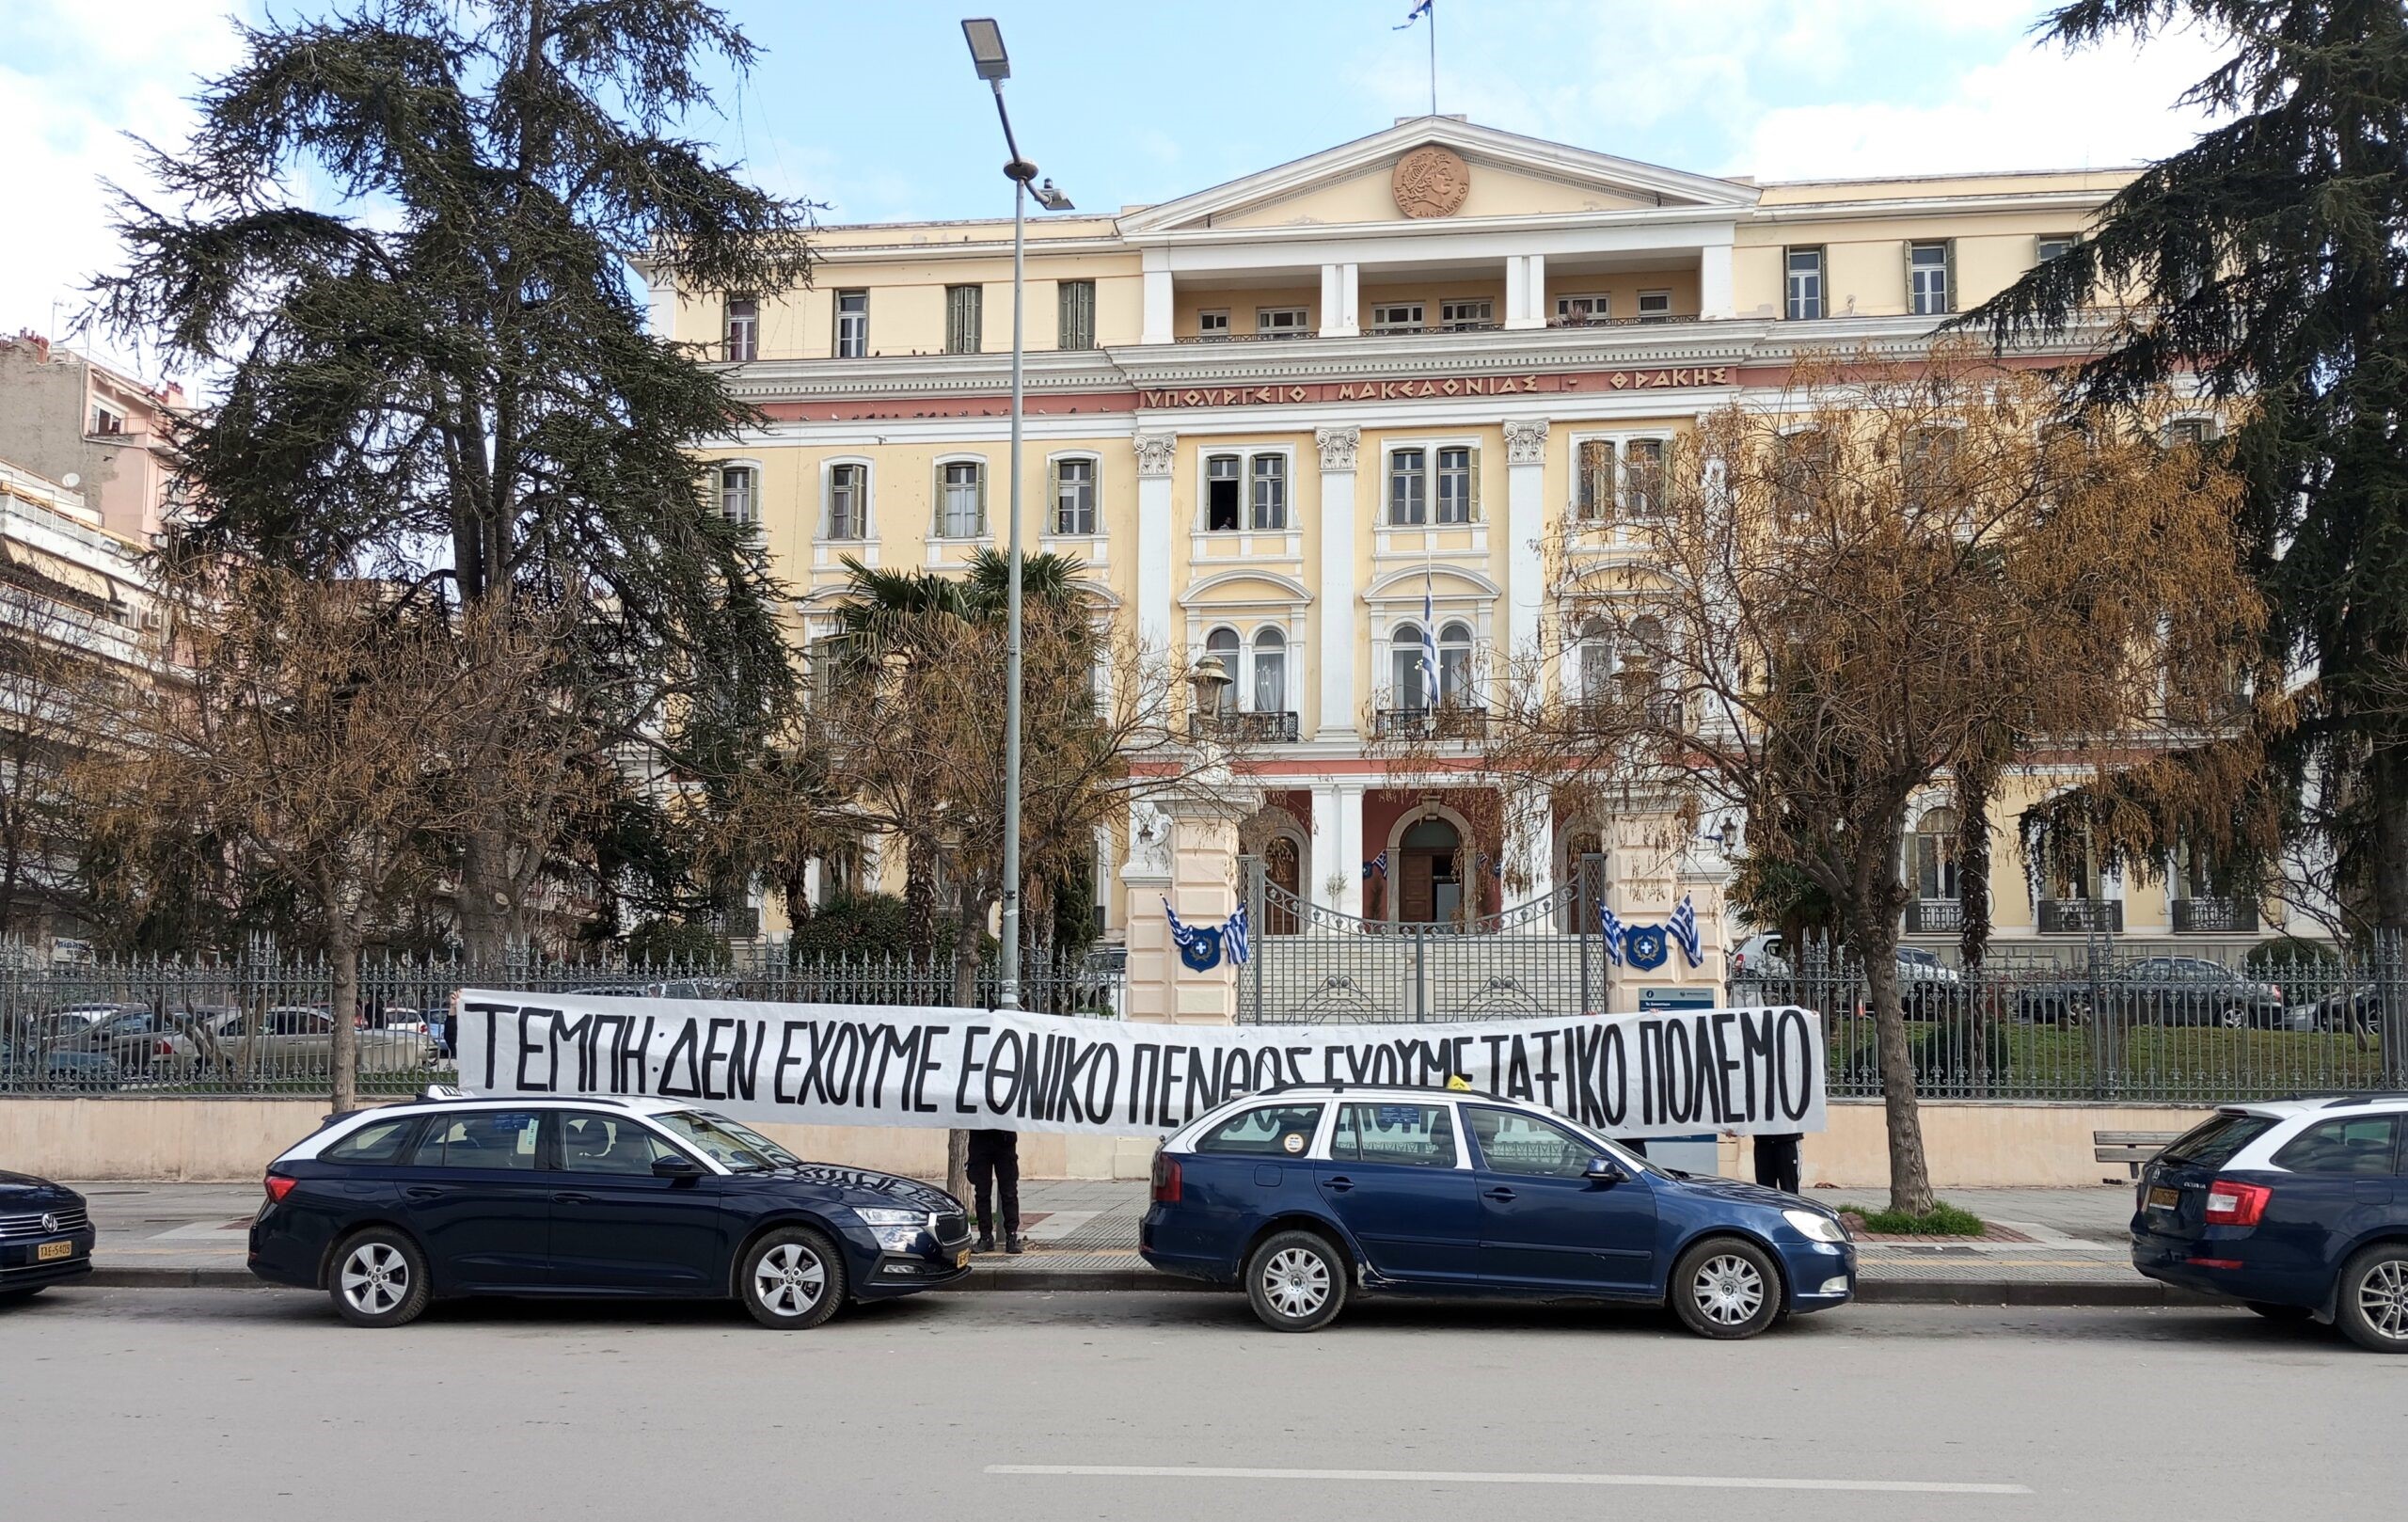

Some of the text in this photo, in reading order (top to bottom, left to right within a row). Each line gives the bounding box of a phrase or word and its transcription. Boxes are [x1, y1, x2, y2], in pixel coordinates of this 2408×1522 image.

[1145, 385, 1307, 408] ΥΠΟΥΡΓΕΙΟ
[1338, 374, 1539, 401] ΜΑΚΕΔΟΝΙΑΣ
[1609, 367, 1728, 390] ΘΡΑΚΗΣ
[657, 1017, 767, 1102] ΔΕΝ
[774, 1021, 950, 1113] ΕΧΟΥΜΕ
[955, 1026, 1119, 1125] ΕΘΝΙΚΟ
[1639, 1009, 1812, 1126] ΠΟΛΕΜΟ
